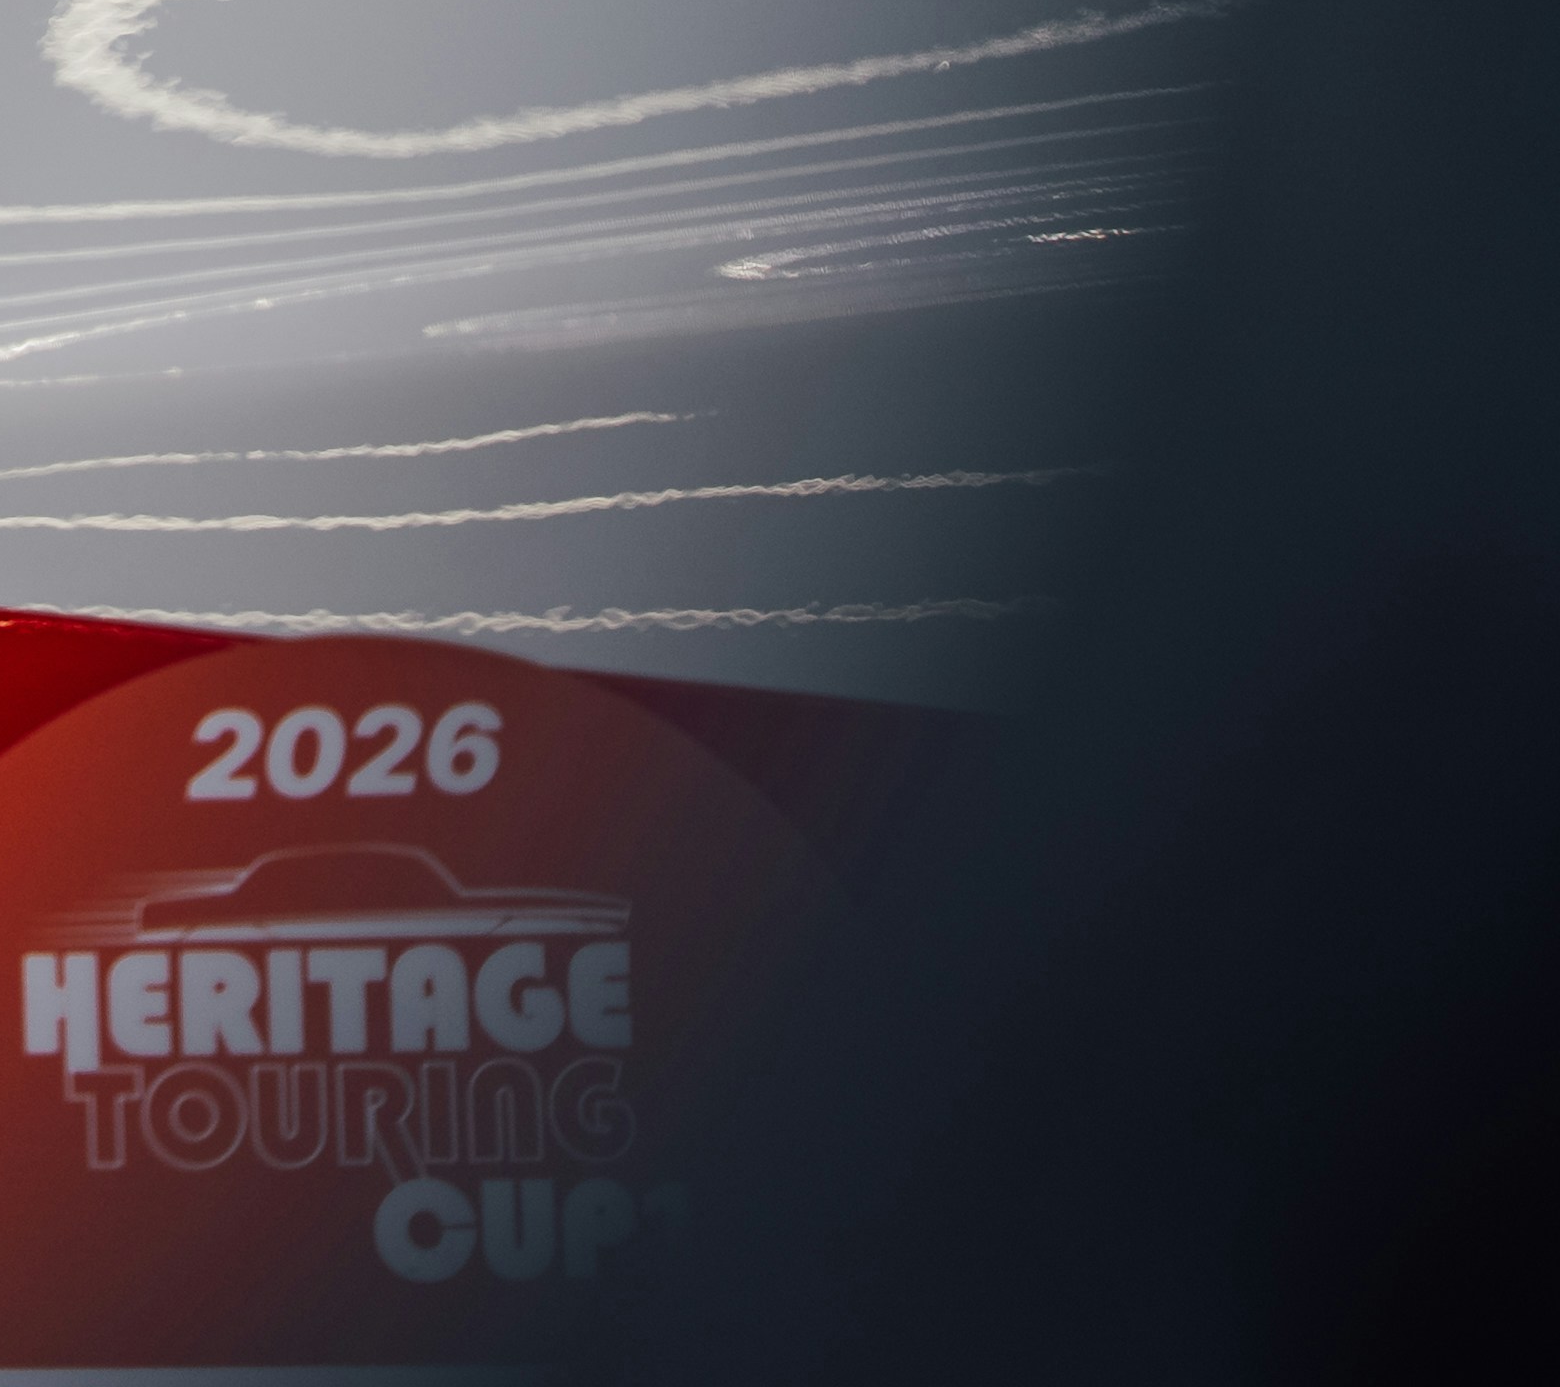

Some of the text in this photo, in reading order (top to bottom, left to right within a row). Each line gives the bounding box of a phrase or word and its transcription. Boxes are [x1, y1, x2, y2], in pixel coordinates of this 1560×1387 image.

[185, 700, 504, 800] 2026
[21, 941, 633, 1075] HERITAGE
[65, 1056, 638, 1175] TOURING
